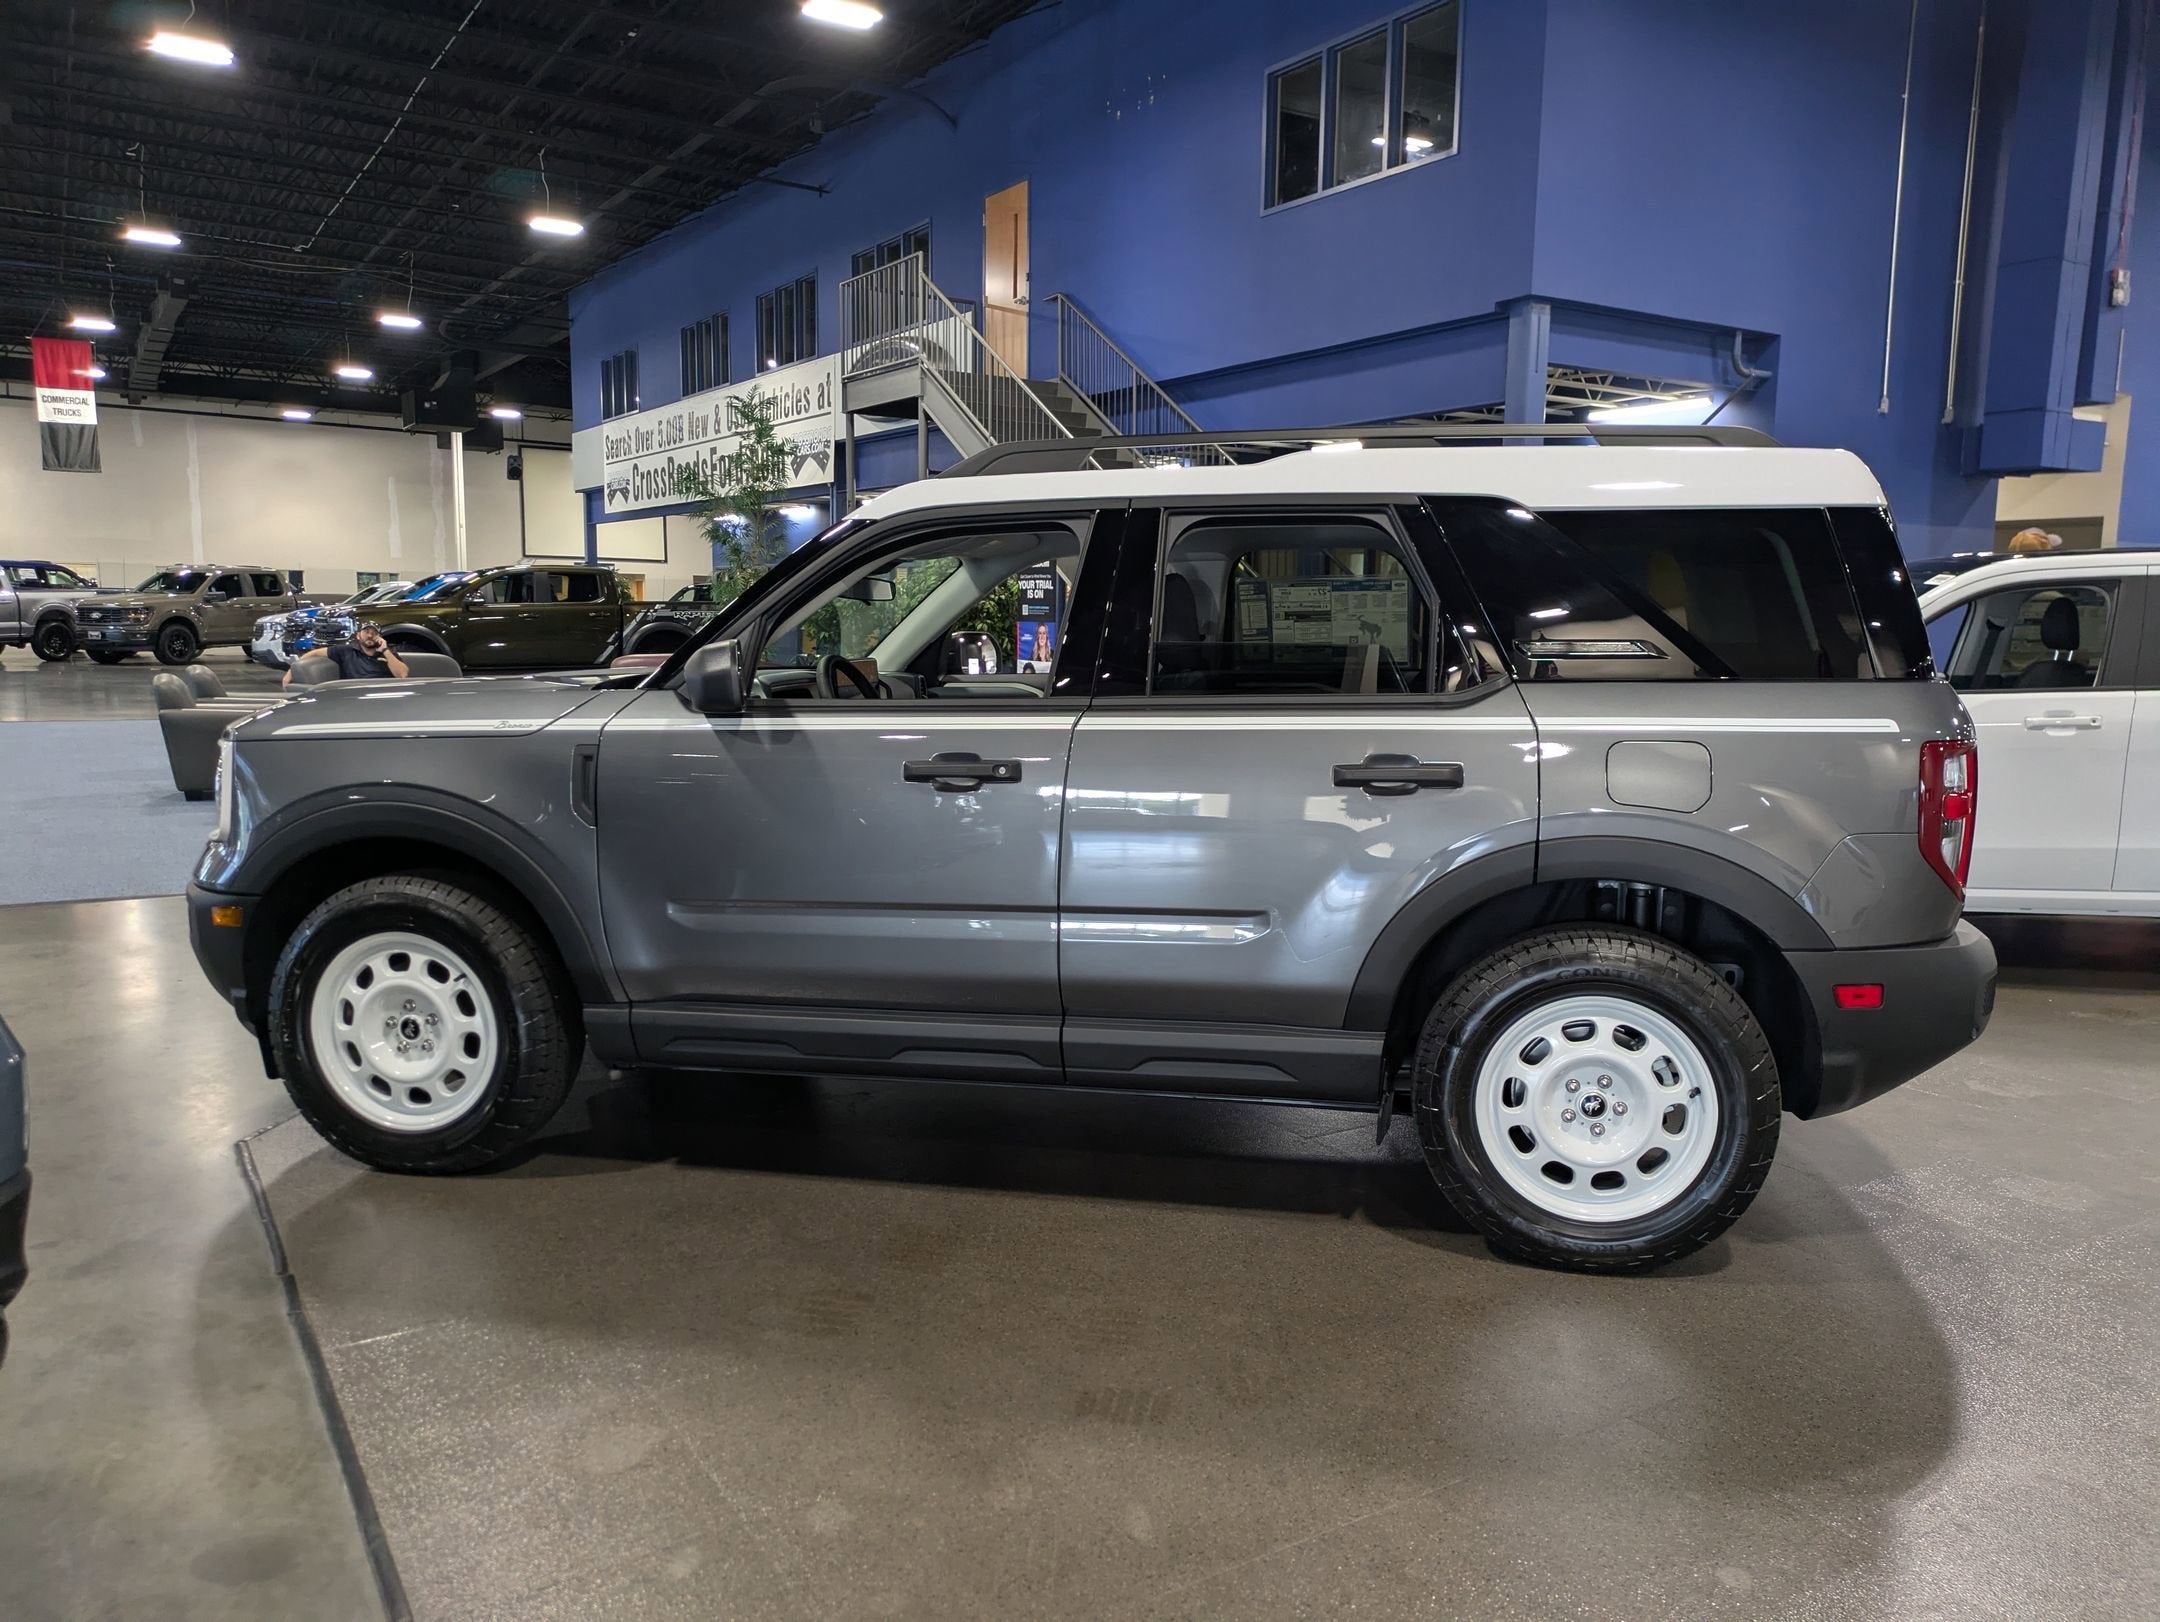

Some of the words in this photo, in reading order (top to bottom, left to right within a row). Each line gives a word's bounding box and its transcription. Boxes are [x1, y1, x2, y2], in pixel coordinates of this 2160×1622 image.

[41, 394, 90, 406] COMMERCIAL
[52, 407, 82, 417] TRUCKS
[605, 429, 633, 461] Search
[634, 426, 655, 454] Over
[687, 410, 709, 441] New
[713, 403, 722, 435] &
[817, 372, 832, 410] at
[1018, 580, 1035, 589] YOUR
[1035, 580, 1054, 589] TRIAL
[1027, 589, 1034, 599] IS
[1034, 589, 1044, 599] ON
